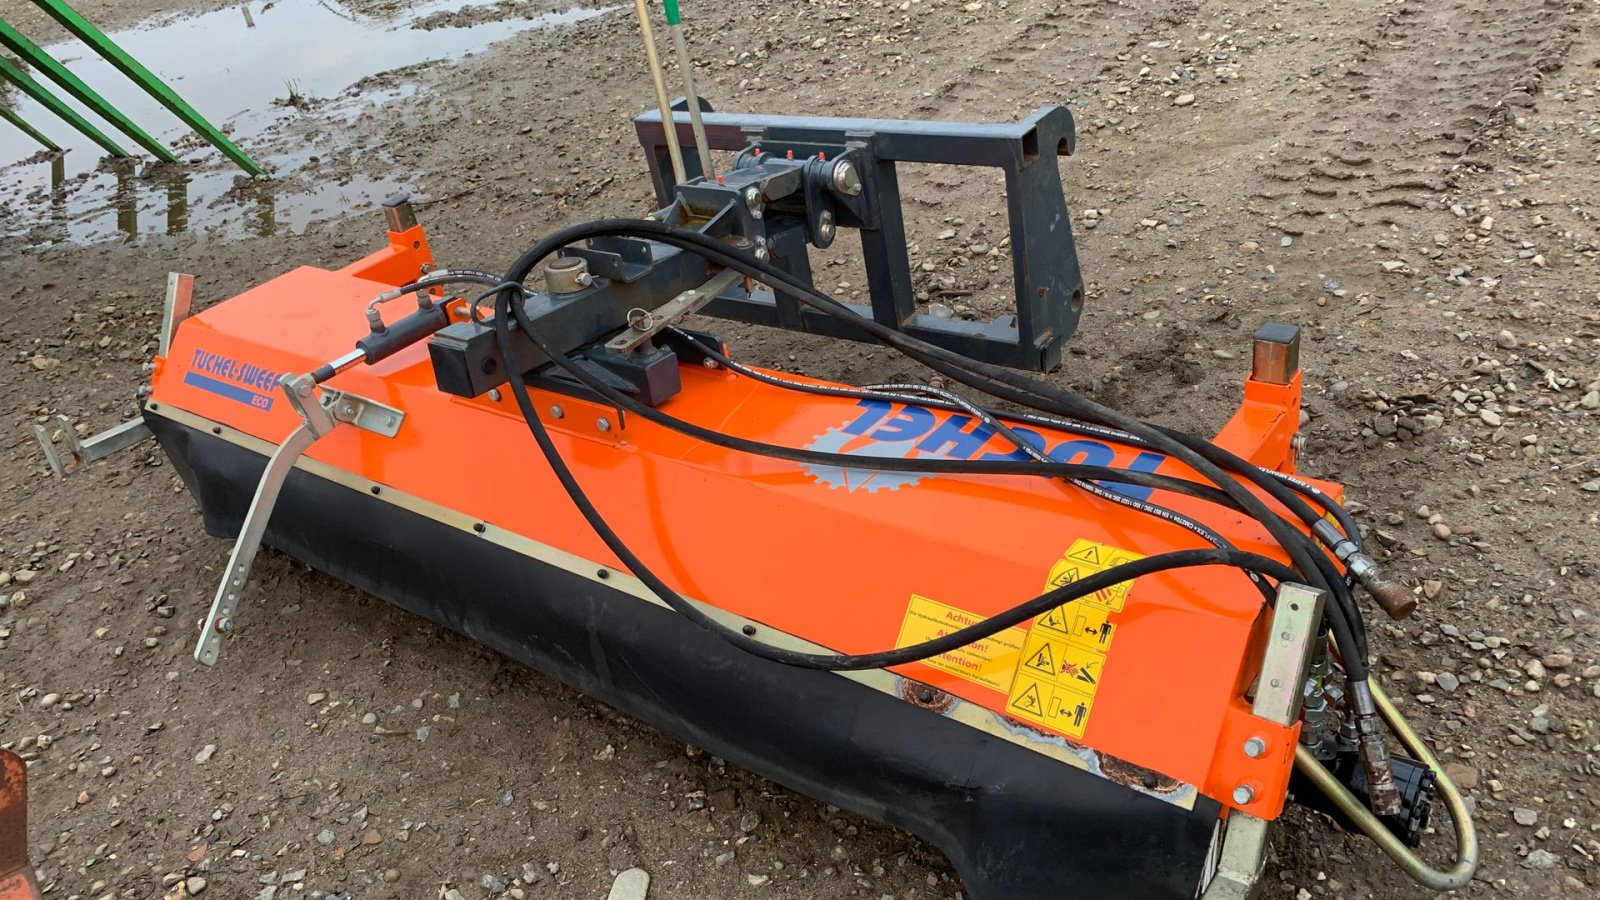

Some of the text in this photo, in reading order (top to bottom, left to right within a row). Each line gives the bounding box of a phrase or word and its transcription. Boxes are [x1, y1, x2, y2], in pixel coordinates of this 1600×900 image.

[251, 395, 268, 409] ECO
[841, 399, 1166, 501] TUCHEL
[946, 611, 979, 626] Achtu
[938, 653, 983, 672] ttention!
